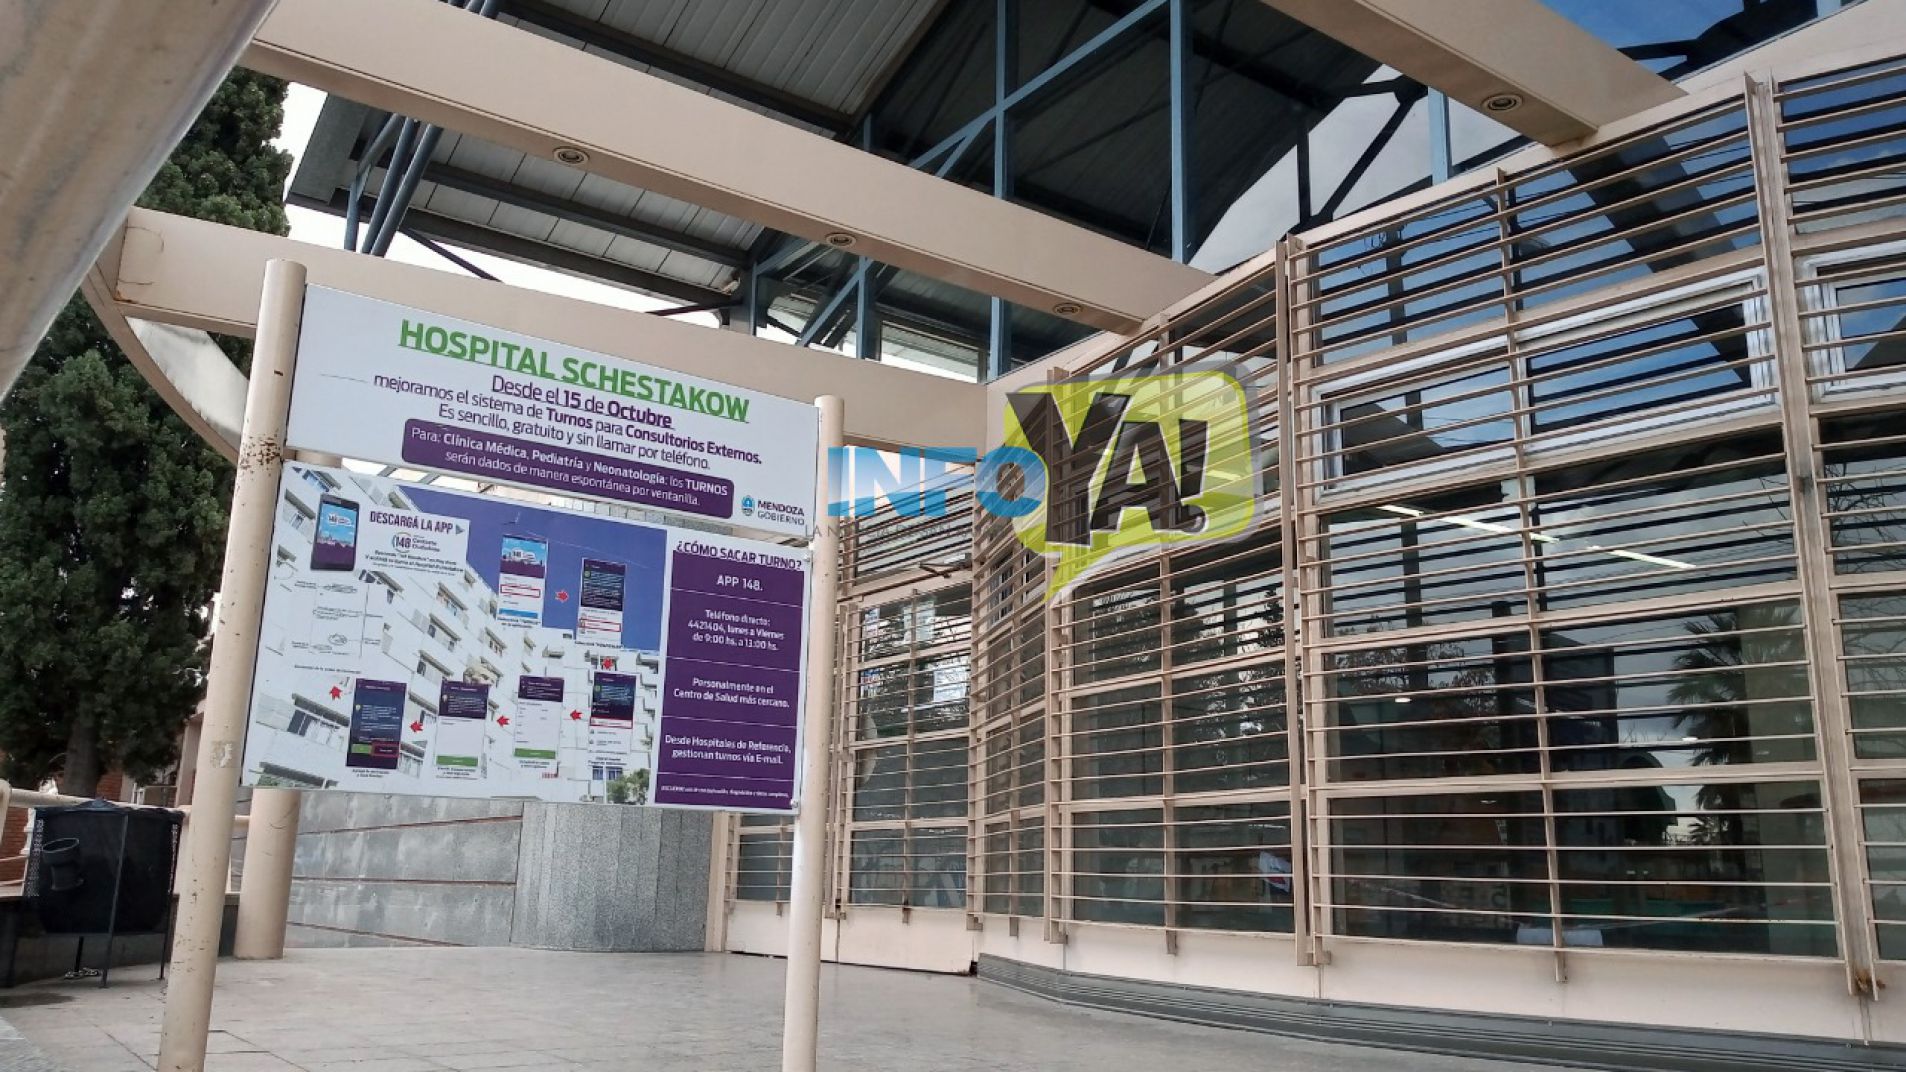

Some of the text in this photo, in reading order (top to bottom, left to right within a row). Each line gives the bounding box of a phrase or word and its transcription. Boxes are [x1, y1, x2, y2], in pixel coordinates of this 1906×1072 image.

[400, 319, 749, 422] HOSPITAL SCHESTAKOW
[492, 375, 672, 428] Desde el 15 de Octubre
[374, 374, 762, 464] mejoramos el sistema de Turnos para Consultorios Externos.
[439, 404, 710, 470] Es sencillo, gratuito y sin llamar por teléfono.
[412, 428, 728, 496] Para: Clínica Médica, Pediatría y Neonatología: los TURNOS
[446, 451, 700, 505] serán dados de manera espontánea por ventanilla.
[757, 500, 804, 516] MENDOZA
[370, 510, 418, 529] DESCARGÁ
[421, 518, 432, 532] LA
[434, 519, 453, 535] APP
[757, 511, 805, 526] GOBIERNO
[676, 541, 802, 570] ¿CÓMO SACAR TURNO?
[716, 574, 763, 591] APP 148.
[705, 609, 740, 623] Teléfono
[692, 632, 703, 642] de
[704, 633, 724, 644] 9:00
[692, 676, 774, 694] Personalmente en el
[673, 688, 702, 699] Centro
[703, 690, 714, 700] de
[714, 692, 738, 703] Salud
[740, 695, 757, 705] más
[665, 734, 691, 745] Desde
[692, 736, 736, 749] Hospitales
[736, 740, 747, 749] de
[714, 750, 741, 761] turnos
